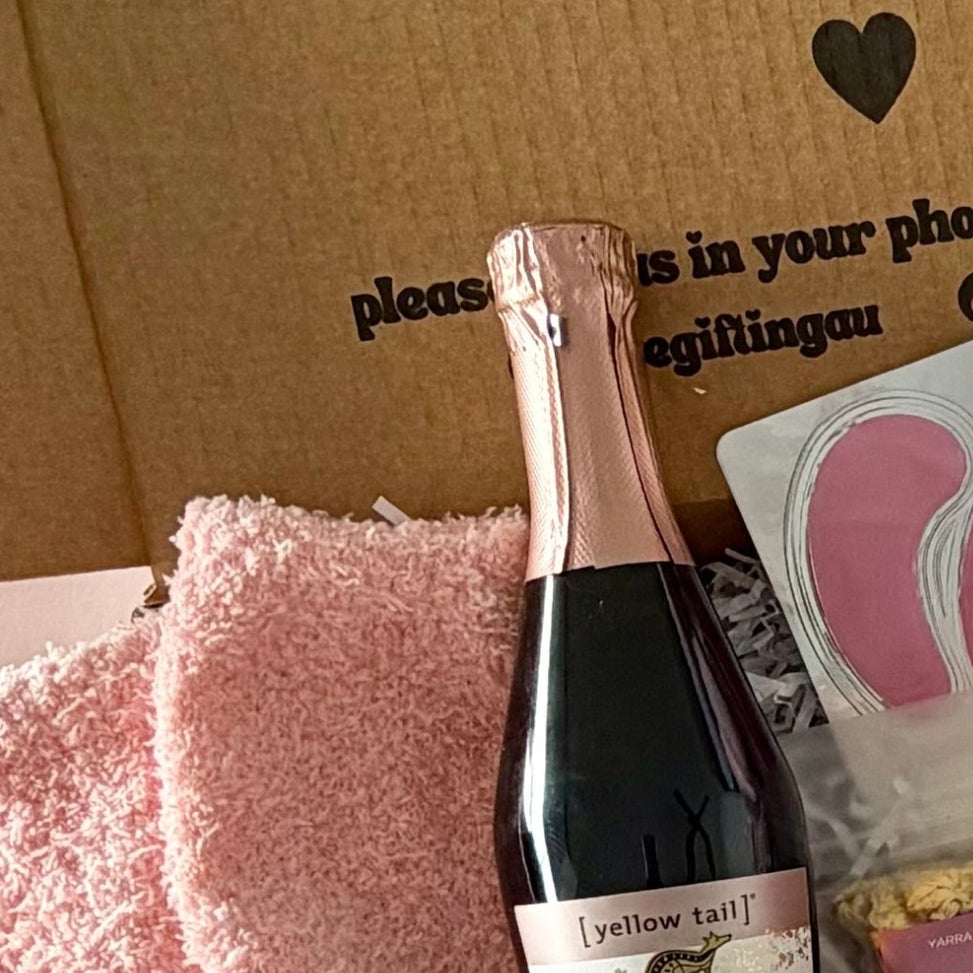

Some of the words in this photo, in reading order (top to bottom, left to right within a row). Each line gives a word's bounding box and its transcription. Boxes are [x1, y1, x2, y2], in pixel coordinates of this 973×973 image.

[350, 277, 494, 341] pleas
[687, 231, 745, 280] in
[751, 220, 876, 283] your
[643, 304, 883, 377] egiftingau
[928, 932, 972, 950] YARRA
